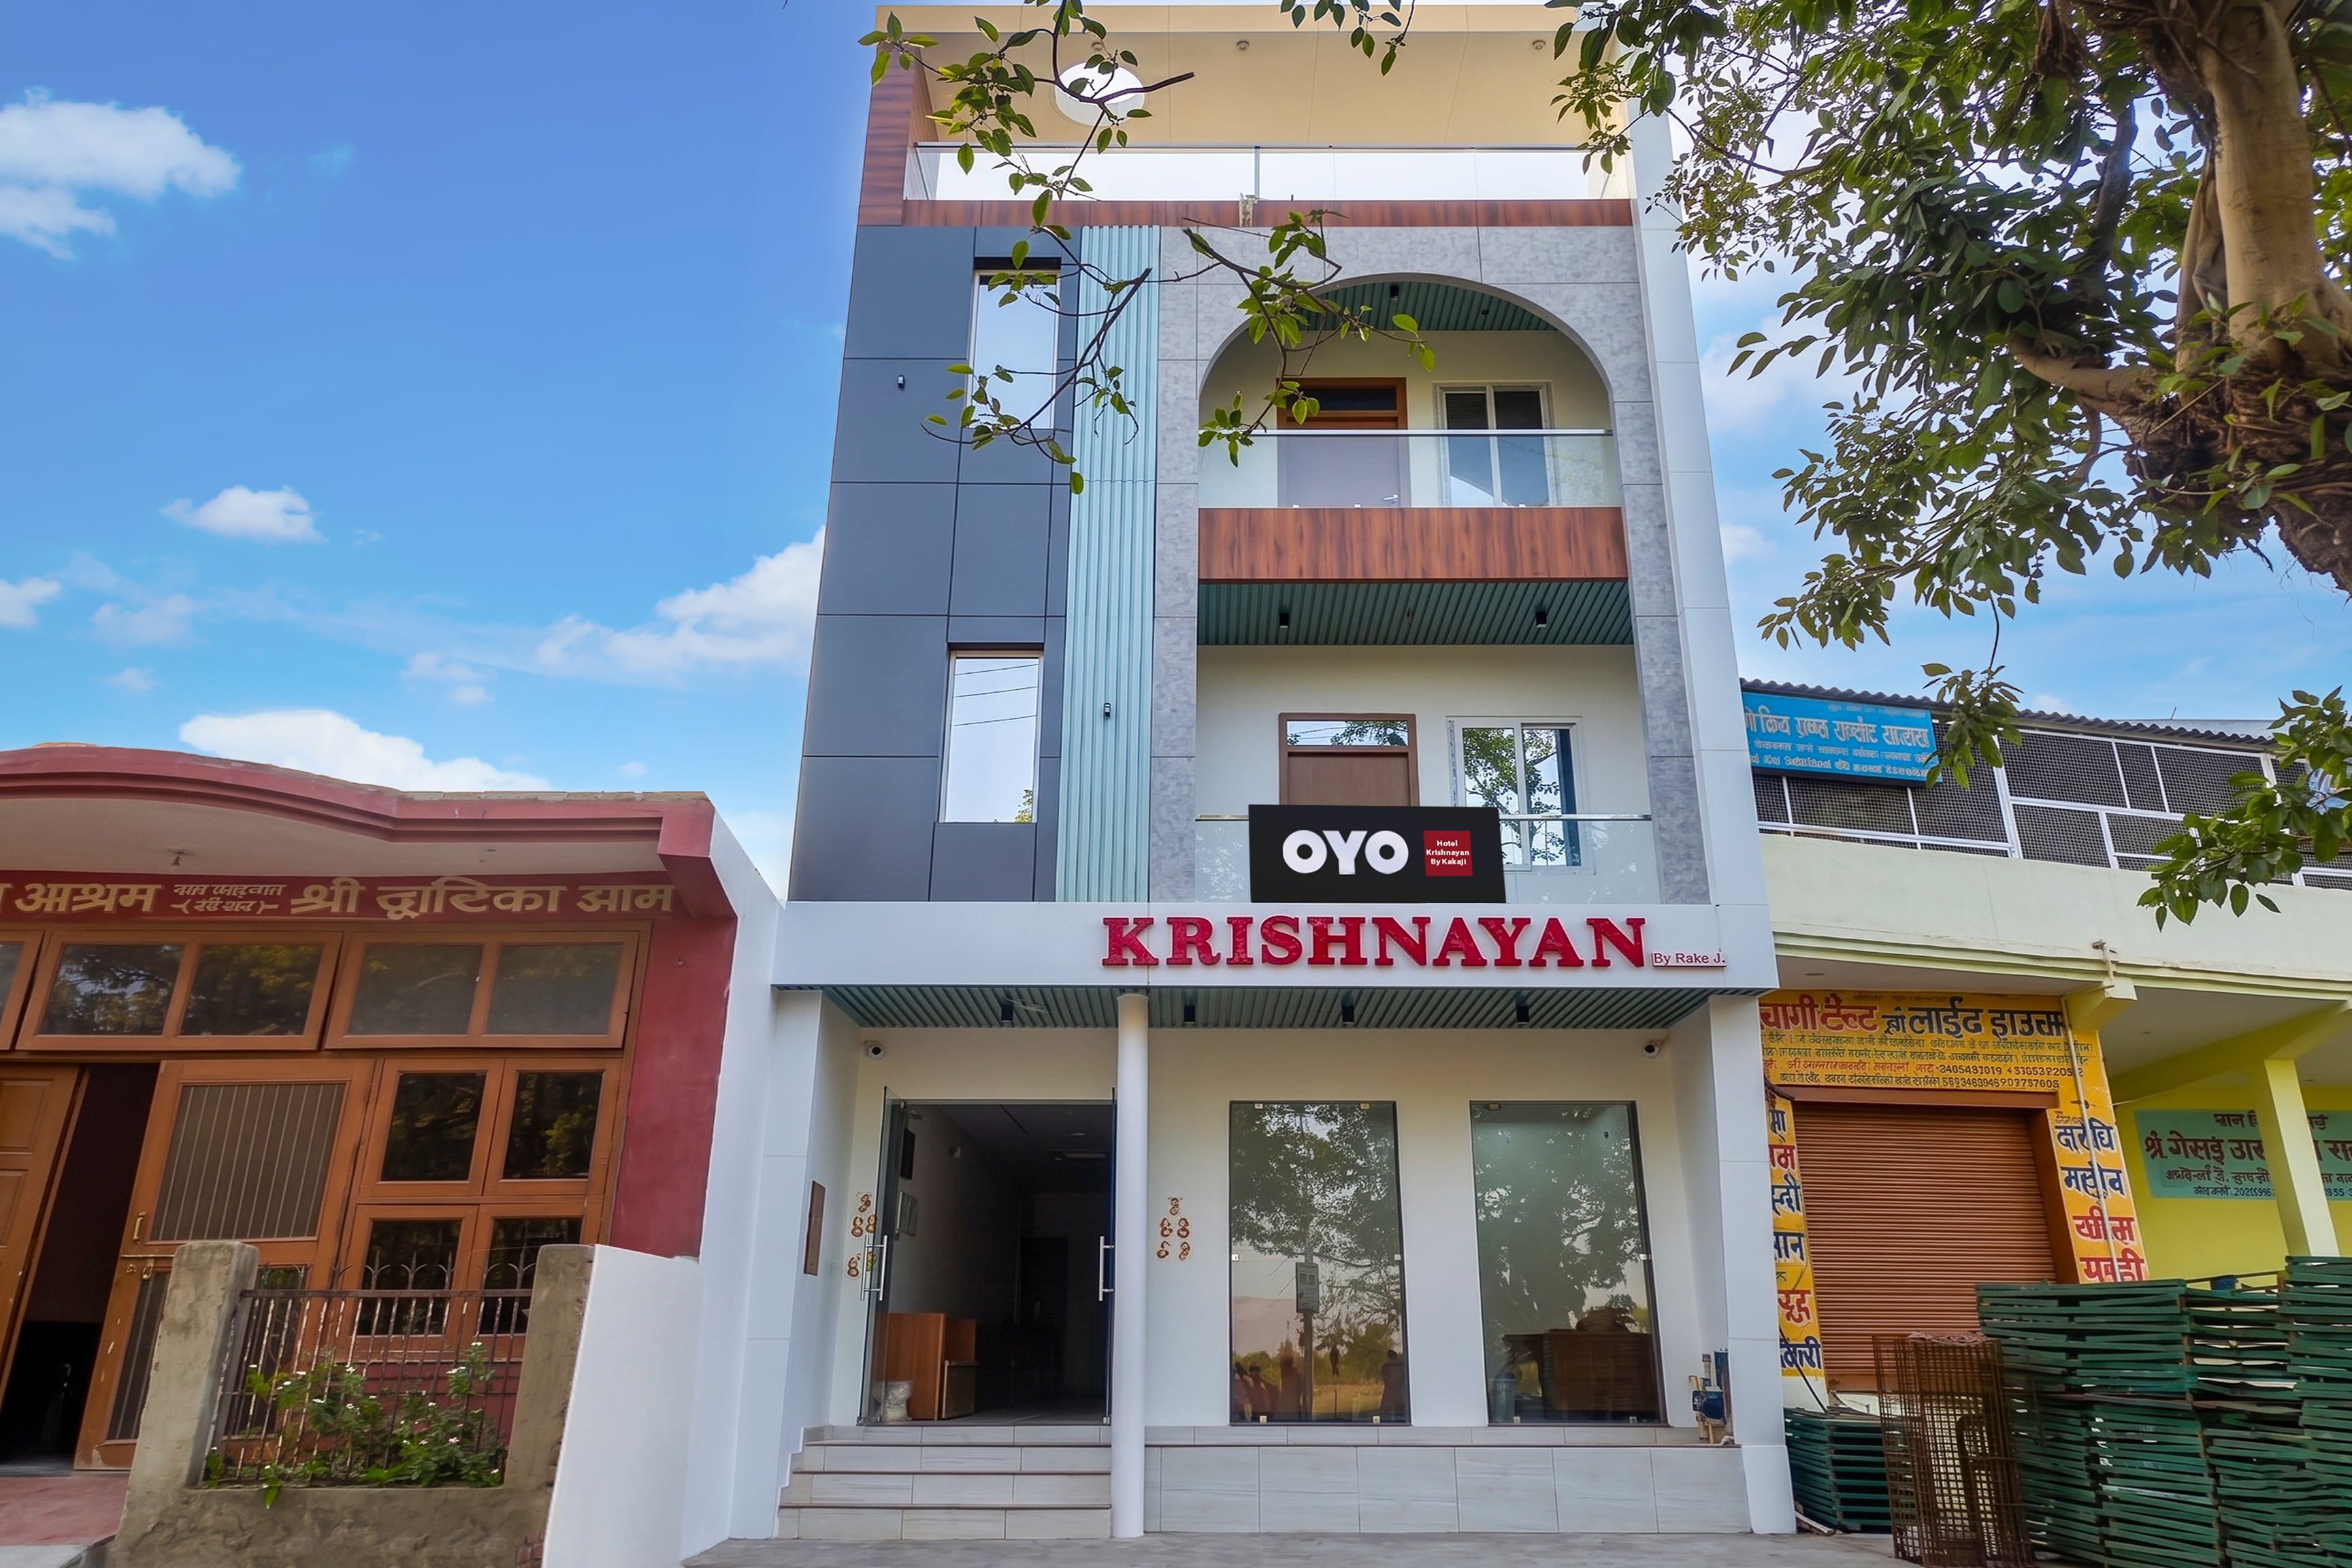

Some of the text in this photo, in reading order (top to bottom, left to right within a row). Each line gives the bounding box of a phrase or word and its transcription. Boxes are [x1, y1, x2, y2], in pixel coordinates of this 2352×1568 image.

[1282, 829, 1409, 875] OYO
[1426, 849, 1470, 858] Krishnayan
[1431, 858, 1467, 866] By Kakaji
[291, 877, 365, 915] श्री
[1102, 915, 1647, 968] KRISHNAYAN
[1653, 953, 1671, 965] By
[1675, 953, 1710, 964] Rake
